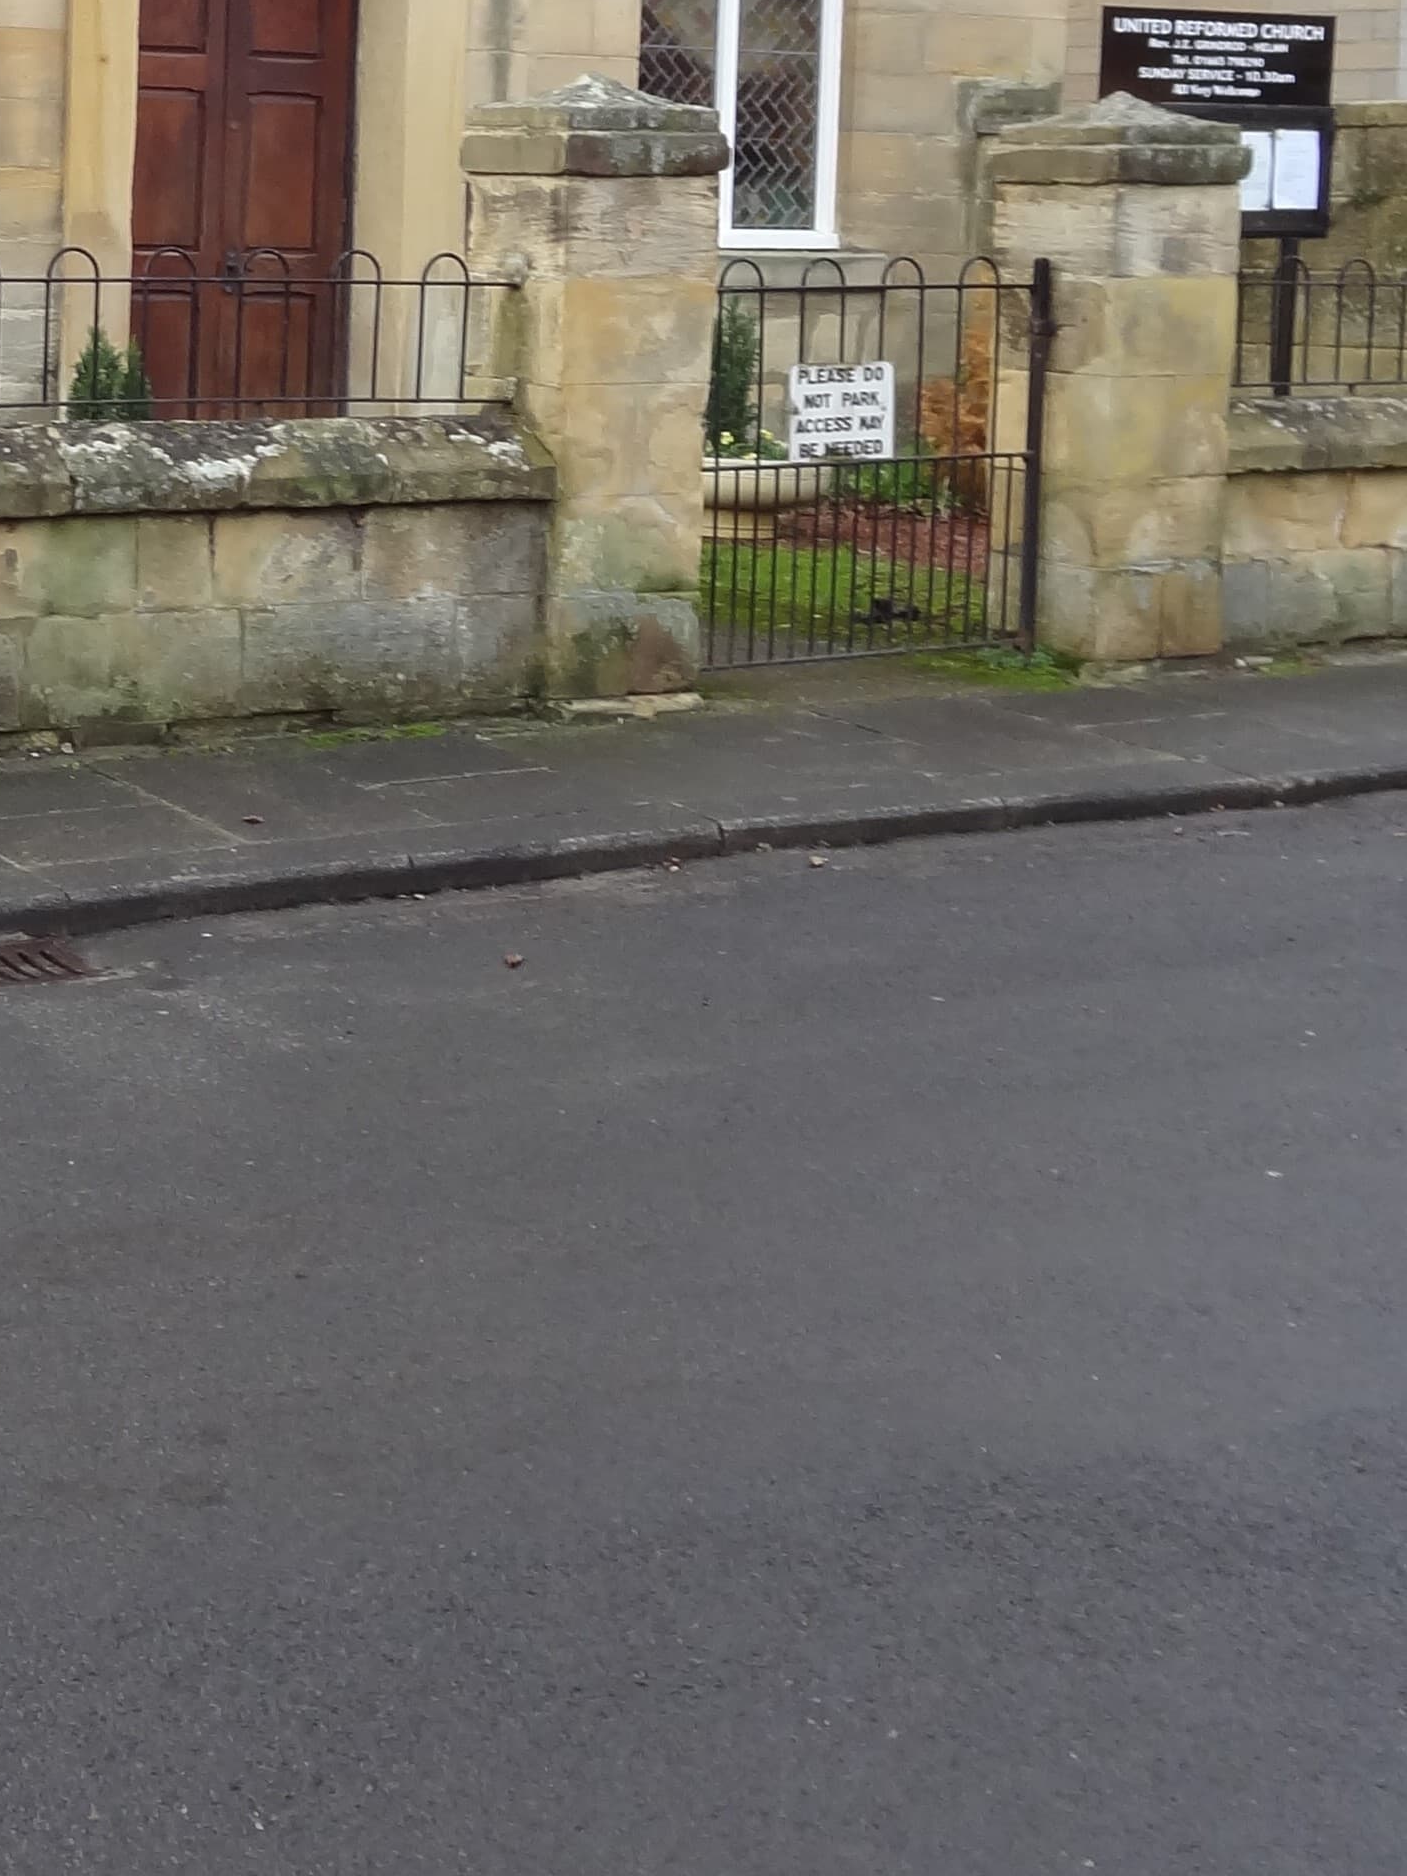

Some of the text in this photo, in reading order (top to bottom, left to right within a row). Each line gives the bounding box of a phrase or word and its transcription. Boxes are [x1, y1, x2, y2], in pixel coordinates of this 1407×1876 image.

[1113, 17, 1326, 41] UNITED REFORMED CHURCH
[1138, 67, 1186, 80] SUNDAY
[1187, 69, 1235, 81] SERVICE
[798, 366, 884, 384] PLEASE DO
[803, 391, 881, 409] NOT PARK
[795, 415, 885, 433] ACCESS MAY
[799, 439, 883, 458] BE NEEDED
